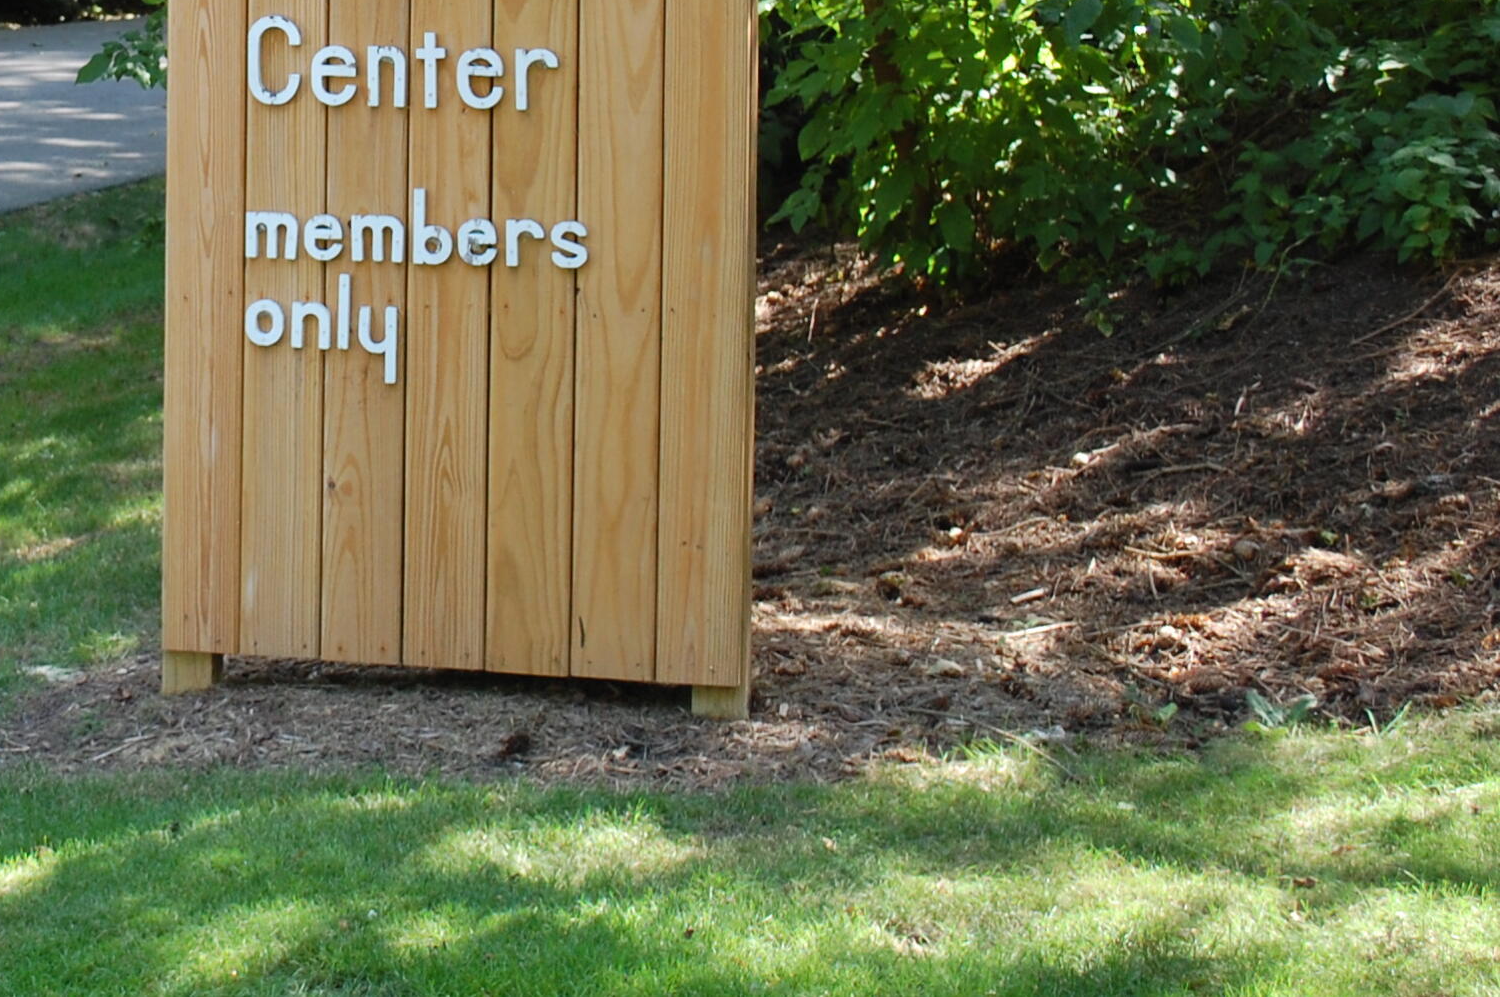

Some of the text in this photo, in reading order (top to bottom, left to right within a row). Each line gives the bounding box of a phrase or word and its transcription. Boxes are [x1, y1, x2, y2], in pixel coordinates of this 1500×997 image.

[247, 14, 559, 111] Center
[245, 187, 589, 269] members
[244, 273, 398, 384] only
